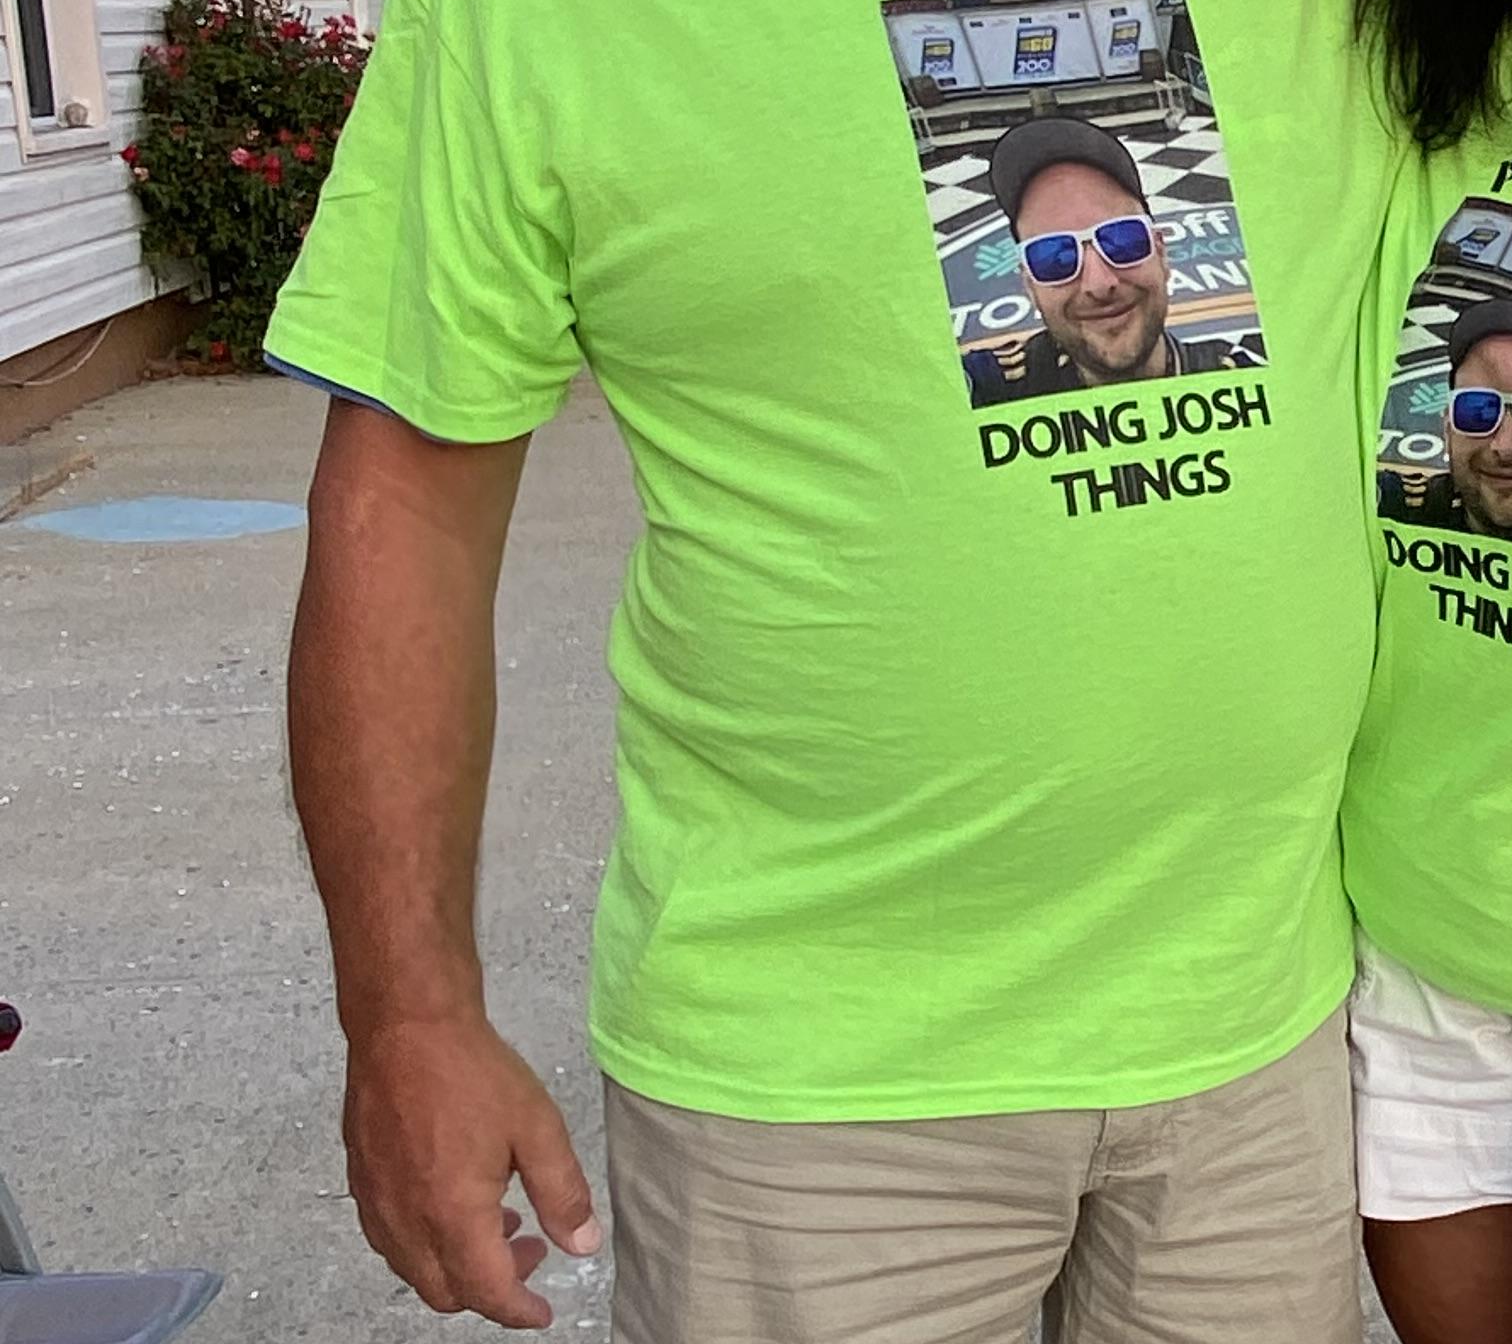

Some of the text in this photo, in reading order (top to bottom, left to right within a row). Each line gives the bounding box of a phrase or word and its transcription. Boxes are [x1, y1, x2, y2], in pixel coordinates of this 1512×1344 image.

[949, 259, 1250, 338] TO AN
[978, 383, 1272, 469] DOING JOSH
[1376, 429, 1450, 462] TO
[1050, 449, 1231, 517] THINGS
[1382, 529, 1510, 591] DOING
